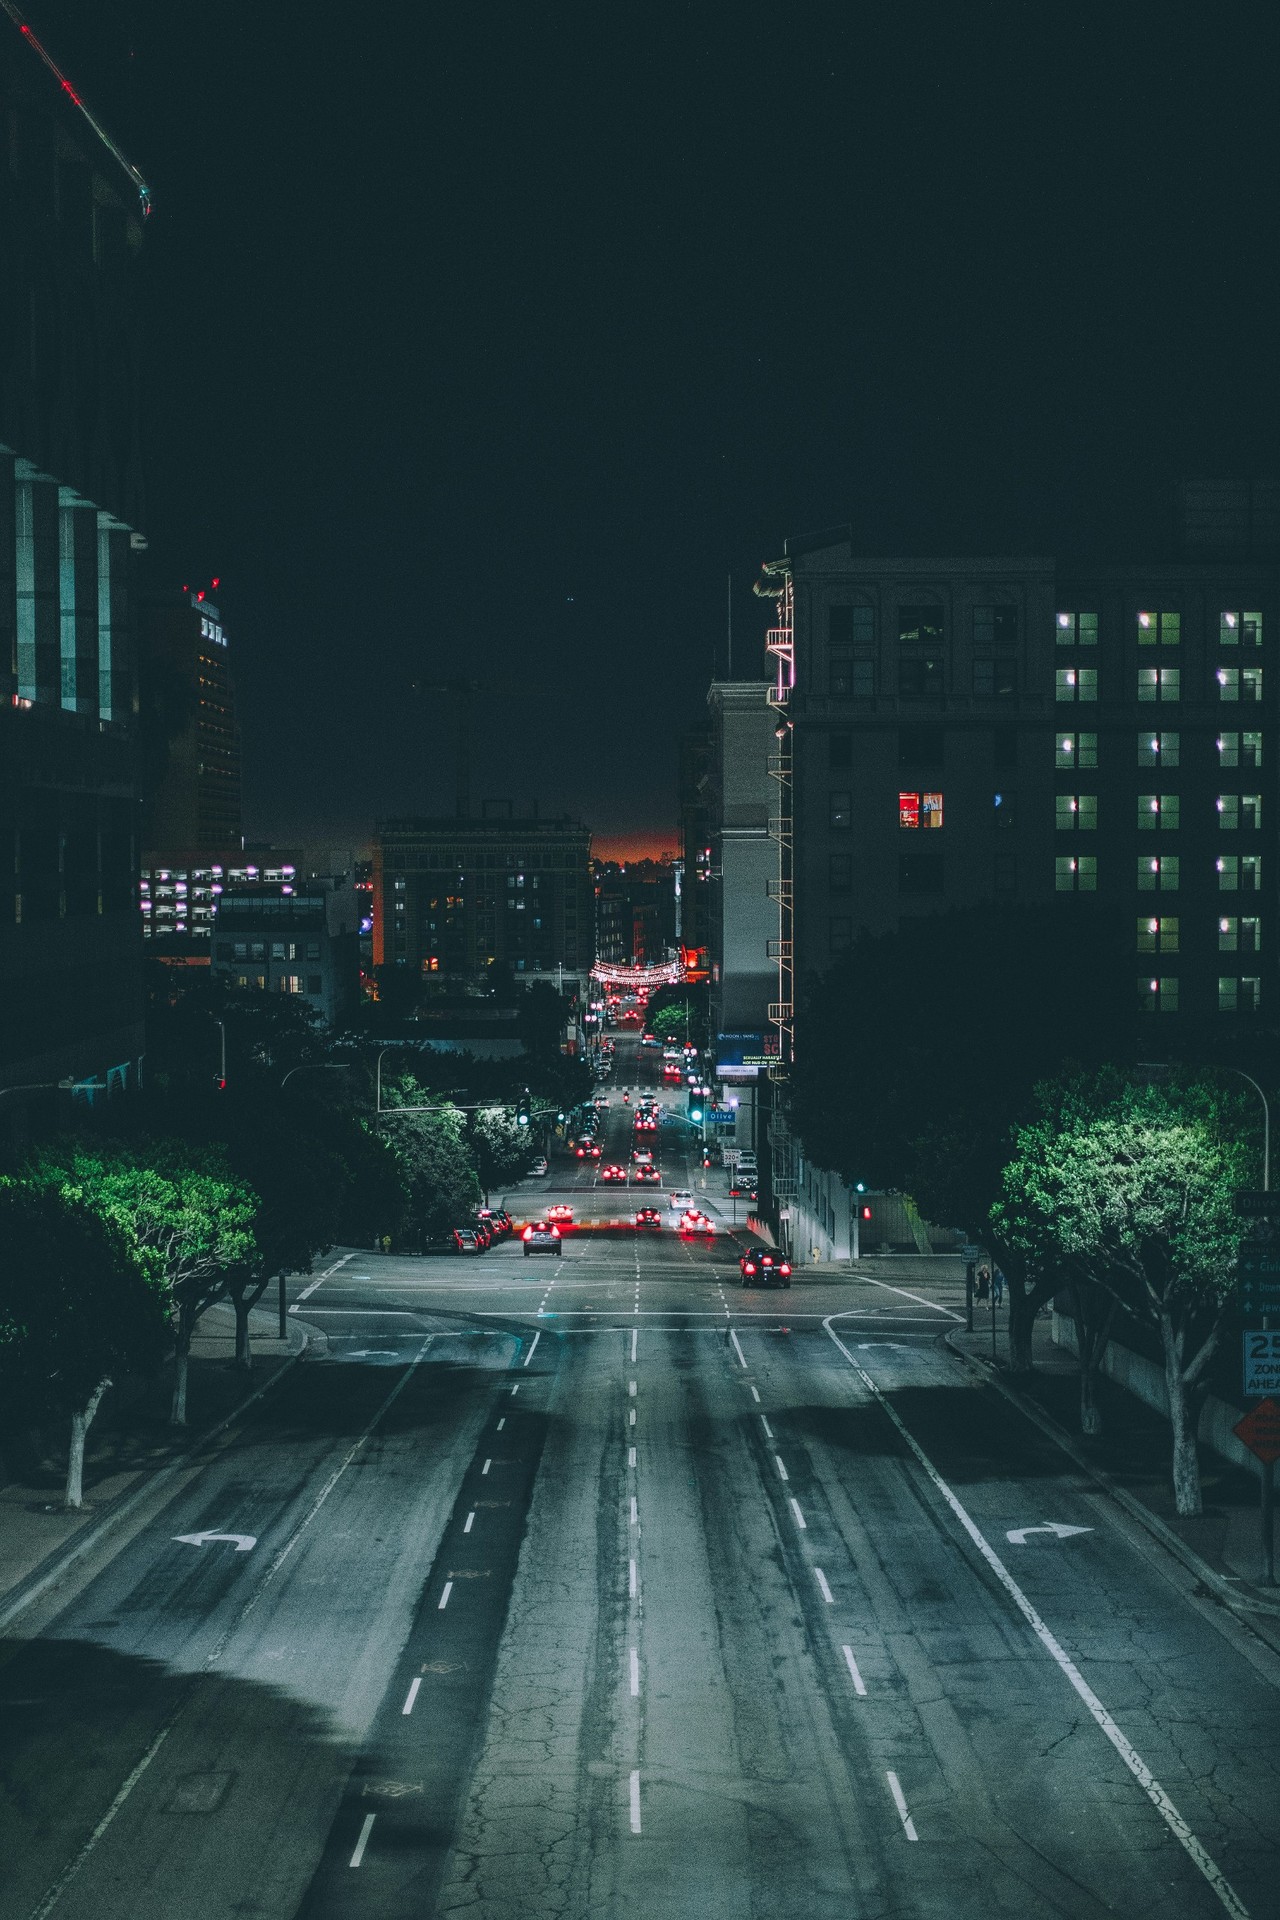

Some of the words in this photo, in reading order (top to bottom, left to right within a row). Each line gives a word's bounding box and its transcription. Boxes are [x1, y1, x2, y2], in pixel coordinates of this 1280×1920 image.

[1242, 1198, 1278, 1208] Olive
[1259, 1261, 1280, 1272] Civi
[1254, 1364, 1280, 1374] ZON
